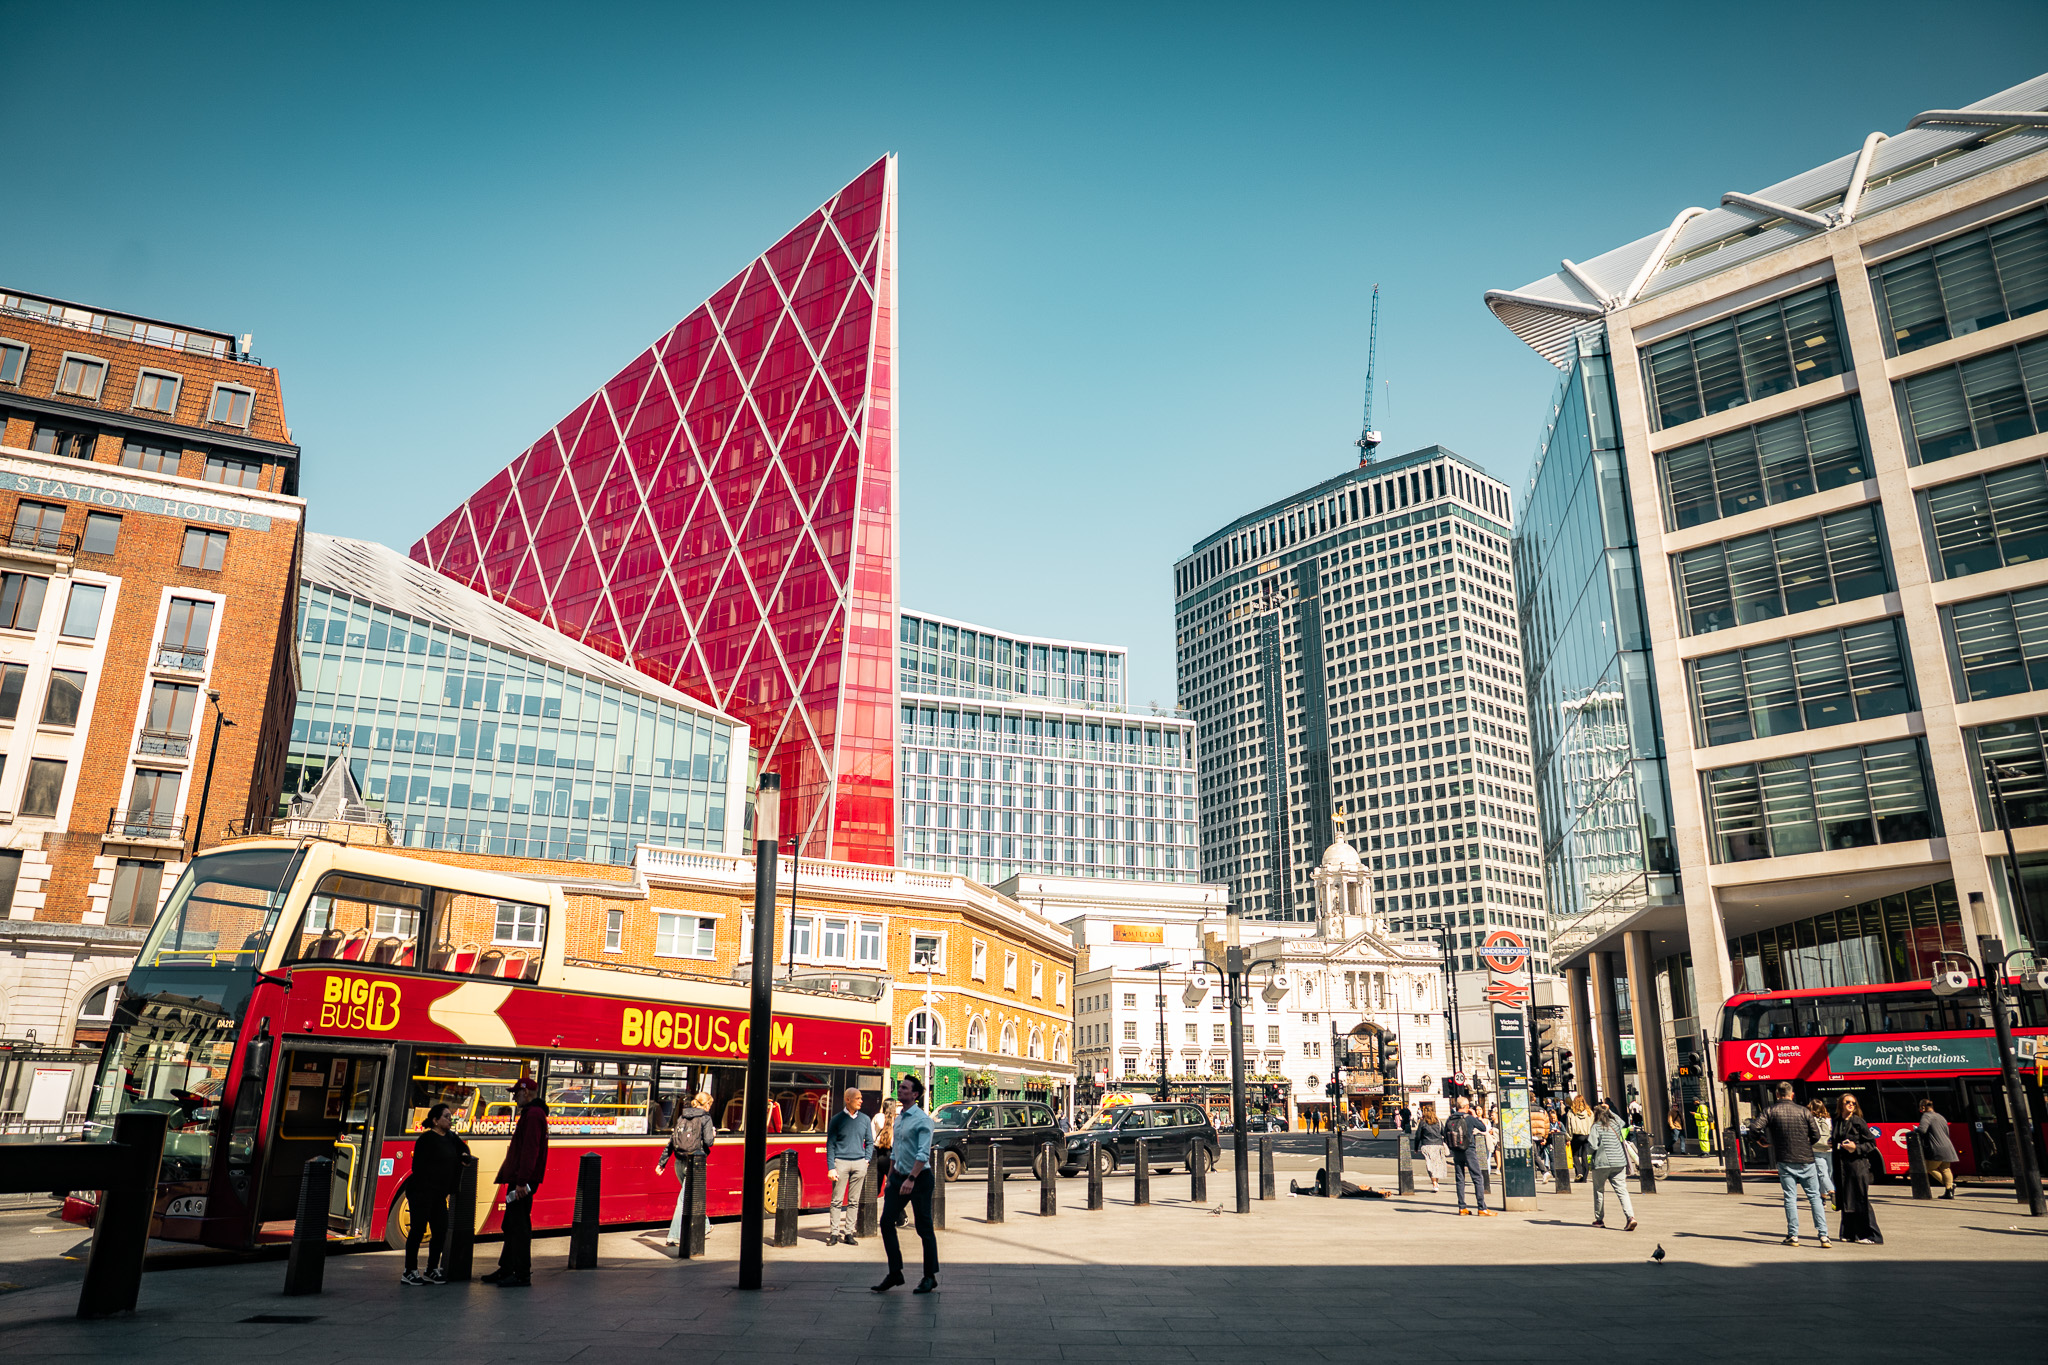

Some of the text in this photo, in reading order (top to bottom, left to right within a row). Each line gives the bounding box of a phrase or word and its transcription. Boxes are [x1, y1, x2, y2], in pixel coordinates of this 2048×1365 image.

[15, 476, 252, 528] STATION HOUSE
[1291, 941, 1432, 954] VICTORIA PALACE
[323, 975, 369, 1006] BIG
[320, 1003, 366, 1030] BUS
[621, 1007, 793, 1057] BIGBUS.CM
[1777, 1050, 1801, 1058] electric
[1875, 1045, 1903, 1053] Above
[1904, 1044, 1920, 1052] the
[1853, 1053, 1969, 1069] Beyond Expectations.
[1455, 1074, 1464, 1082] 20
[1542, 1067, 1551, 1076] 04
[1679, 1067, 1689, 1076] 04
[472, 1120, 517, 1134] HOP-OFF
